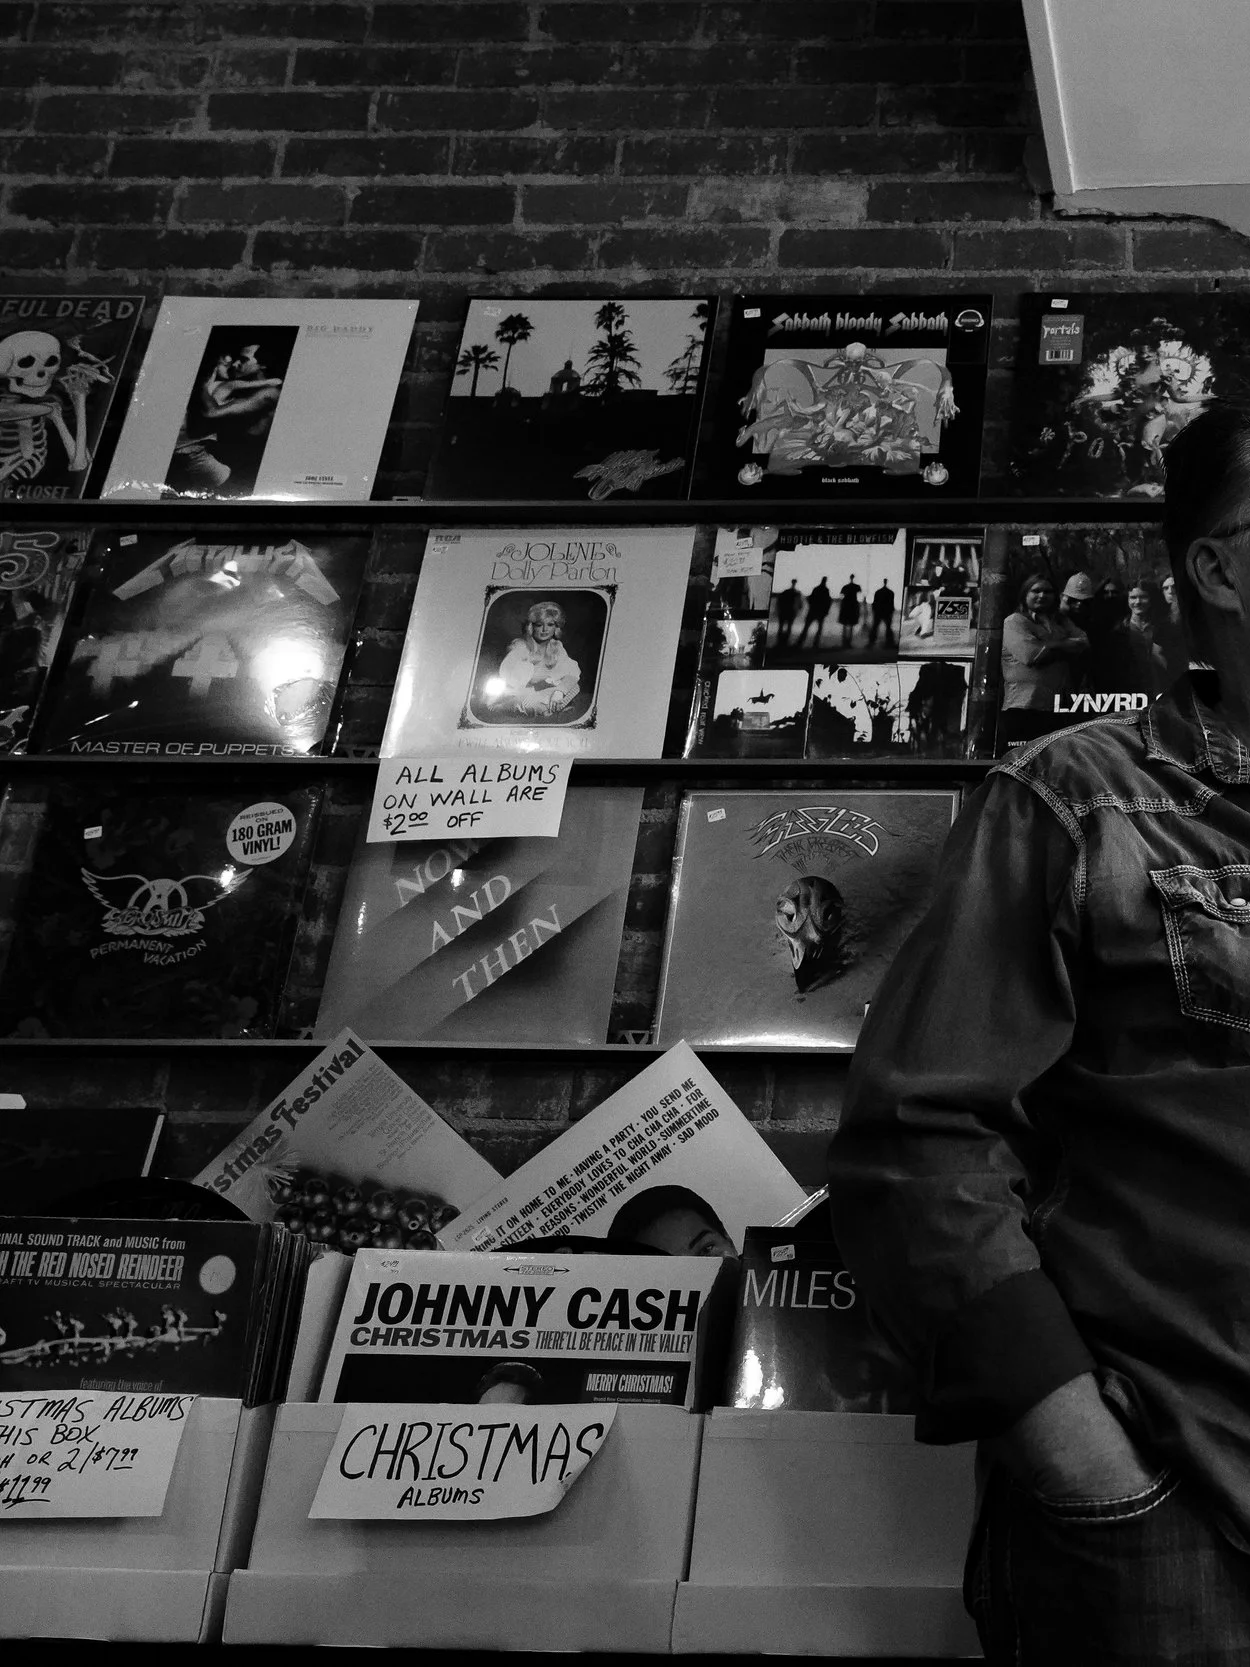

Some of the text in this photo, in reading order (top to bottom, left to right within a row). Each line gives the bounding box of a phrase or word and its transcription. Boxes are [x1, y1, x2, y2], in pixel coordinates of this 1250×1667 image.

[56, 300, 135, 319] DEAD
[886, 311, 949, 337] Sabbath
[780, 534, 813, 544] HOOTIE
[827, 534, 843, 544] THE
[847, 534, 894, 544] BLOWFISH
[510, 542, 606, 563] JOLENE
[491, 561, 623, 585] Dolly Parton
[1054, 693, 1148, 713] LYNYRD
[70, 741, 294, 756] MASTER OF PUPPETS
[396, 763, 560, 785] ALL ALBUMS
[383, 785, 549, 810] ON WALL ARE
[232, 819, 292, 842] 180 GRAM
[447, 811, 484, 828] OFF
[242, 836, 281, 856] VINYL!
[431, 875, 513, 954] AND
[90, 939, 174, 959] PERMANENT
[143, 939, 207, 966] VACATION
[452, 904, 562, 1002] THEN
[267, 1034, 370, 1136] Festival
[495, 1225, 506, 1237] IT
[505, 1214, 519, 1228] ON
[519, 1196, 543, 1217] HOME
[543, 1186, 556, 1198] TO
[556, 1174, 571, 1188] ME
[572, 1149, 603, 1175] HAVING
[601, 1143, 610, 1153] A
[609, 1124, 636, 1147] PARTY
[640, 1106, 659, 1123] YOU
[659, 1088, 682, 1108] SEND
[681, 1077, 696, 1091] ME
[540, 1178, 587, 1217] EVERYBODY
[587, 1158, 613, 1181] LOVES
[613, 1147, 626, 1160] TO
[627, 1133, 645, 1150] CHA
[644, 1119, 663, 1137] CHA
[661, 1106, 679, 1123] CHA
[686, 1088, 703, 1104] FOR
[539, 1097, 711, 1235] REASONS WONDERFUL WORLD SUMMERTIME
[572, 1107, 719, 1224] TWISTIN' THE NIGHT AWAY SAD MOOD
[27, 1234, 64, 1247] SOUND
[67, 1235, 102, 1248] TRACK
[103, 1236, 123, 1249] and
[125, 1236, 160, 1249] MUSIC
[162, 1237, 186, 1250] from
[10, 1251, 38, 1277] THE
[37, 1251, 68, 1278] RED
[68, 1252, 116, 1279] NOSED
[117, 1254, 185, 1281] REINDEER
[44, 1279, 93, 1288] MUSICAL
[98, 1280, 181, 1290] SPECTACULAR
[743, 1269, 856, 1310] MILES
[353, 1282, 701, 1332] JOHNNY CASH
[349, 1327, 693, 1354] CHRISTMAS THERE'LL BE PEACE IN THE VALLEY
[79, 1377, 117, 1392] featuring
[117, 1379, 132, 1391] the
[132, 1380, 153, 1392] voice
[586, 1373, 674, 1394] MERRY CHRISTMAS!
[103, 1395, 199, 1422] ALBUMS
[50, 1424, 101, 1445] BOX
[27, 1451, 52, 1466] OR
[339, 1422, 604, 1485] CHRISTMAS
[396, 1485, 485, 1509] ALBUMS
